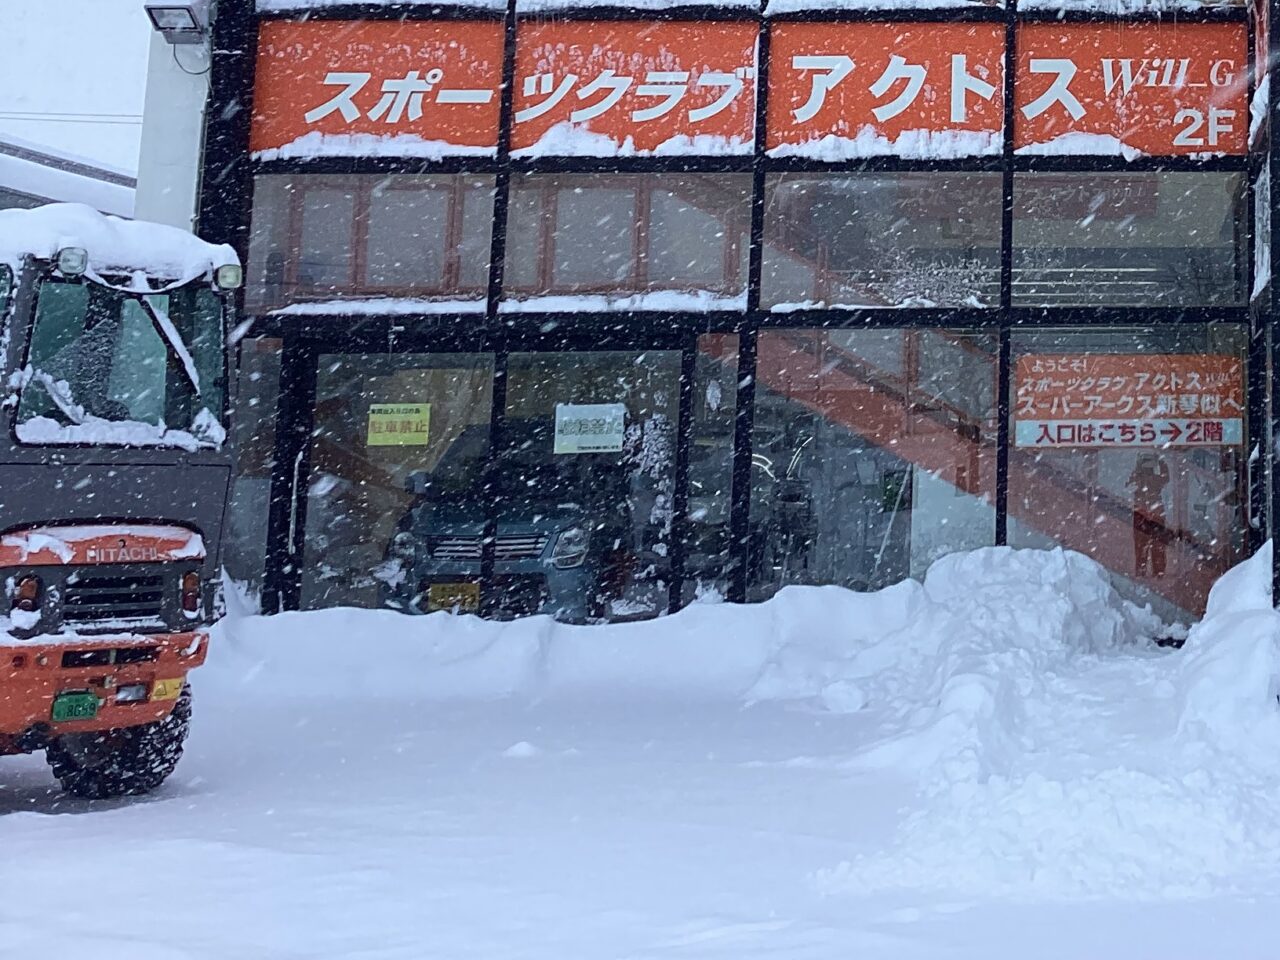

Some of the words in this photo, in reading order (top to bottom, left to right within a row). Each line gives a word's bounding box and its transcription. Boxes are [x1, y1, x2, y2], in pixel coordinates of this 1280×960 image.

[1172, 106, 1236, 146] 2F
[1036, 423, 1157, 444] 入口はこちら
[1185, 421, 1224, 443] 2階
[86, 546, 158, 562] HITACHI
